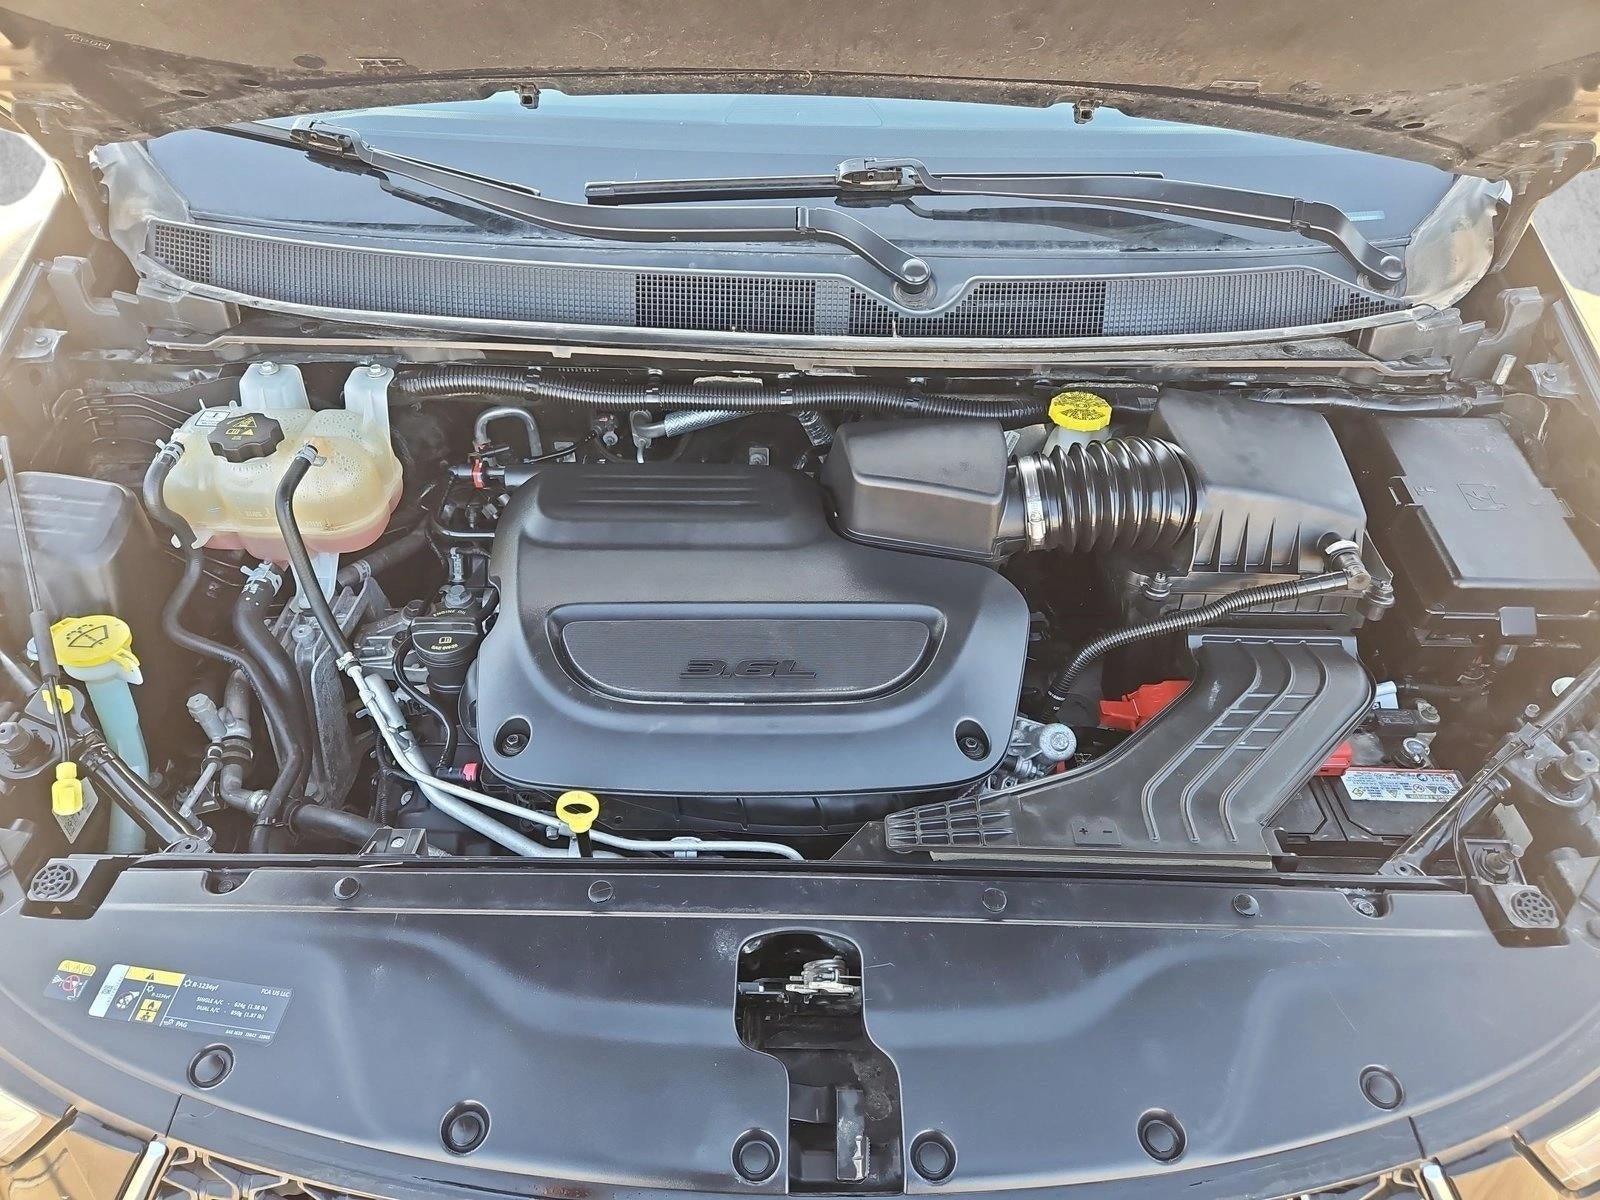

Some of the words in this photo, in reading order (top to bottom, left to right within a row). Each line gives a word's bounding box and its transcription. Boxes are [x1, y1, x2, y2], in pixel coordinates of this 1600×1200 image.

[679, 658, 817, 679] 3.6L
[191, 981, 219, 992] R-1234yf
[280, 990, 291, 998] LLC
